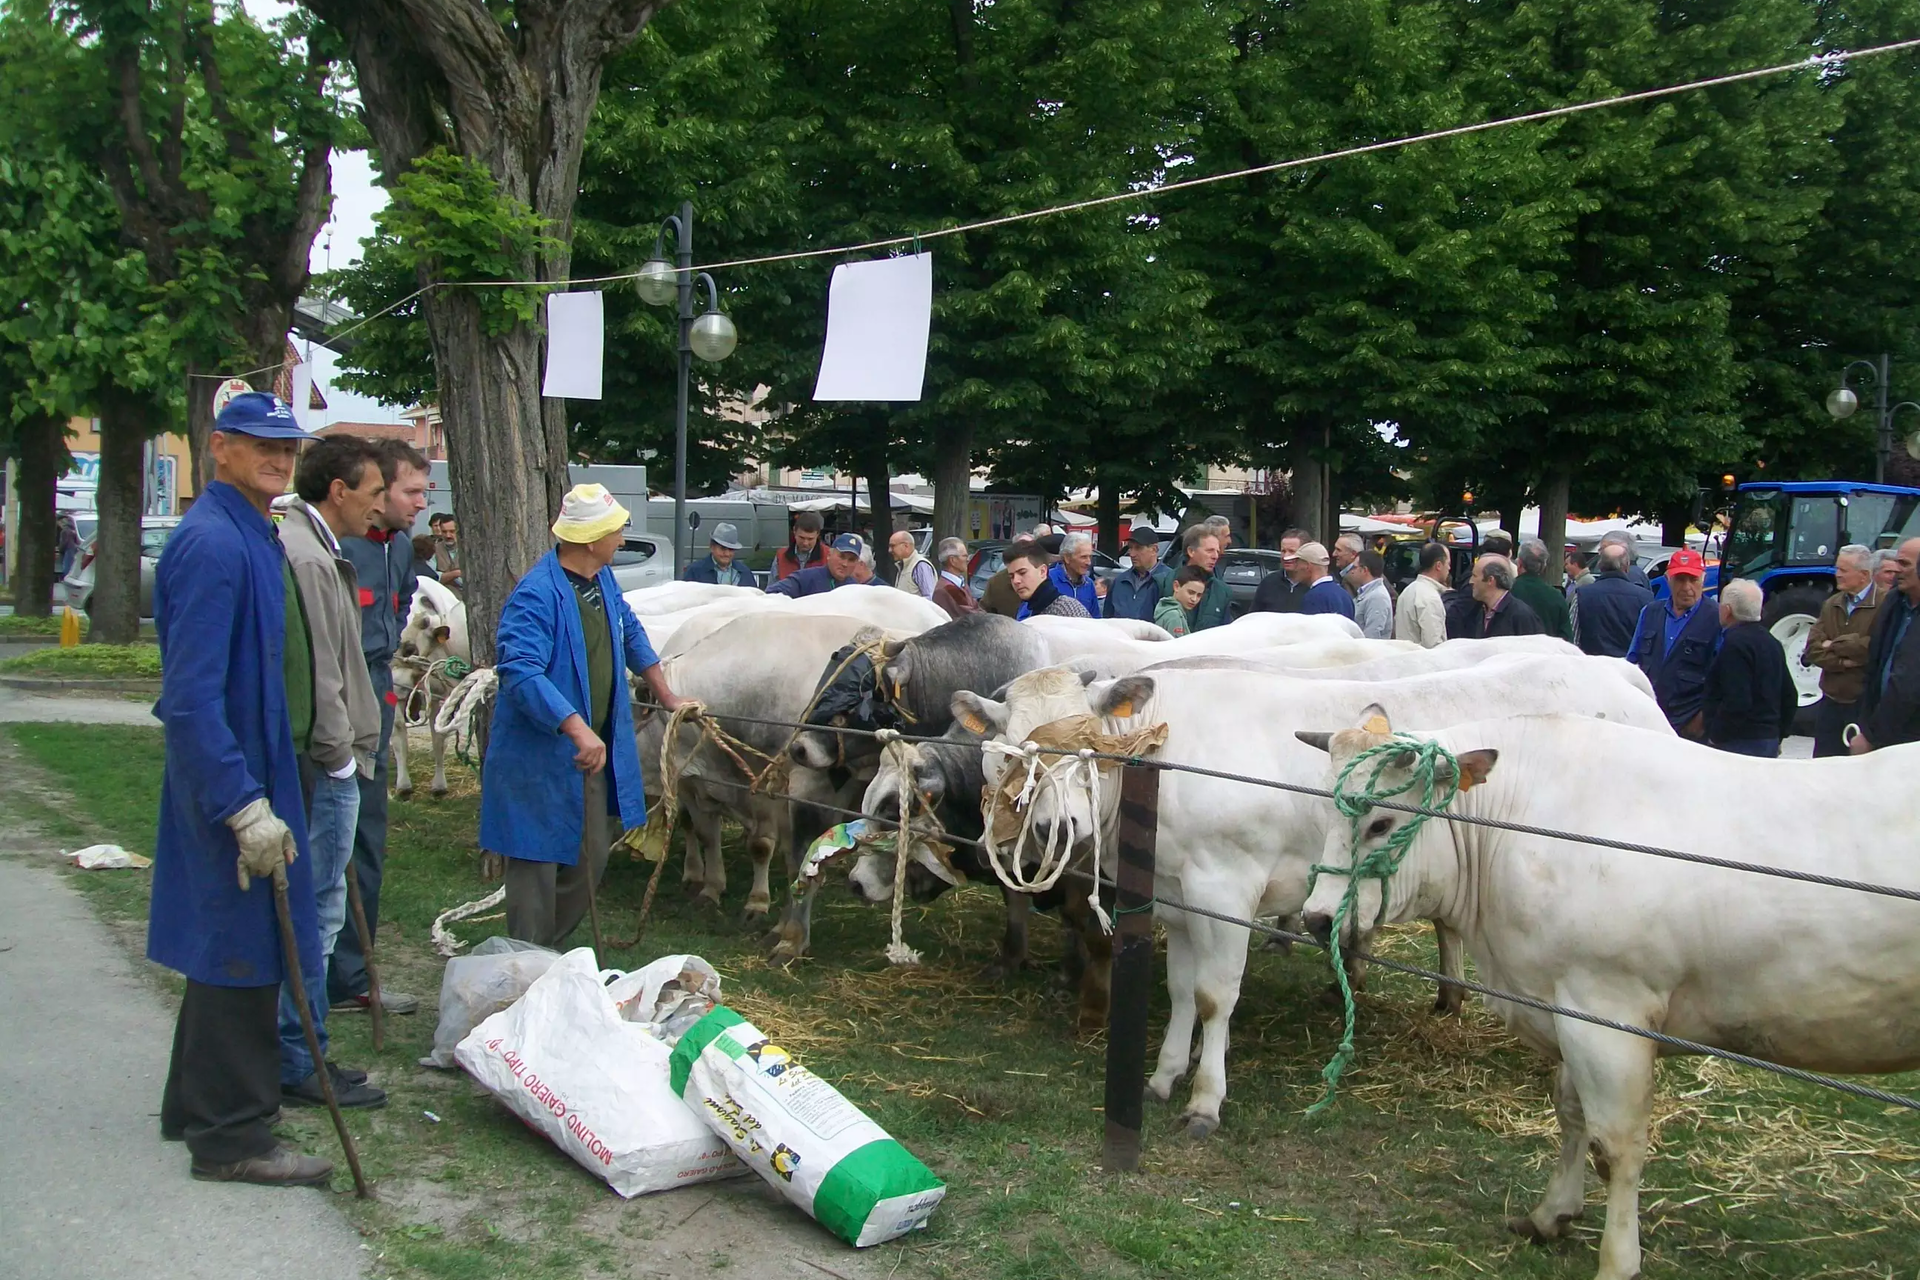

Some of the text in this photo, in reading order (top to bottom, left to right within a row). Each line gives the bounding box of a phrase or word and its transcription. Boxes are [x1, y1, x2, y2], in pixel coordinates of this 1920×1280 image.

[503, 1051, 527, 1078] TIPO
[524, 1074, 566, 1118] GAIERO
[743, 1114, 762, 1130] del
[567, 1114, 613, 1165] MOLINO
[677, 1167, 709, 1179] GAIERO
